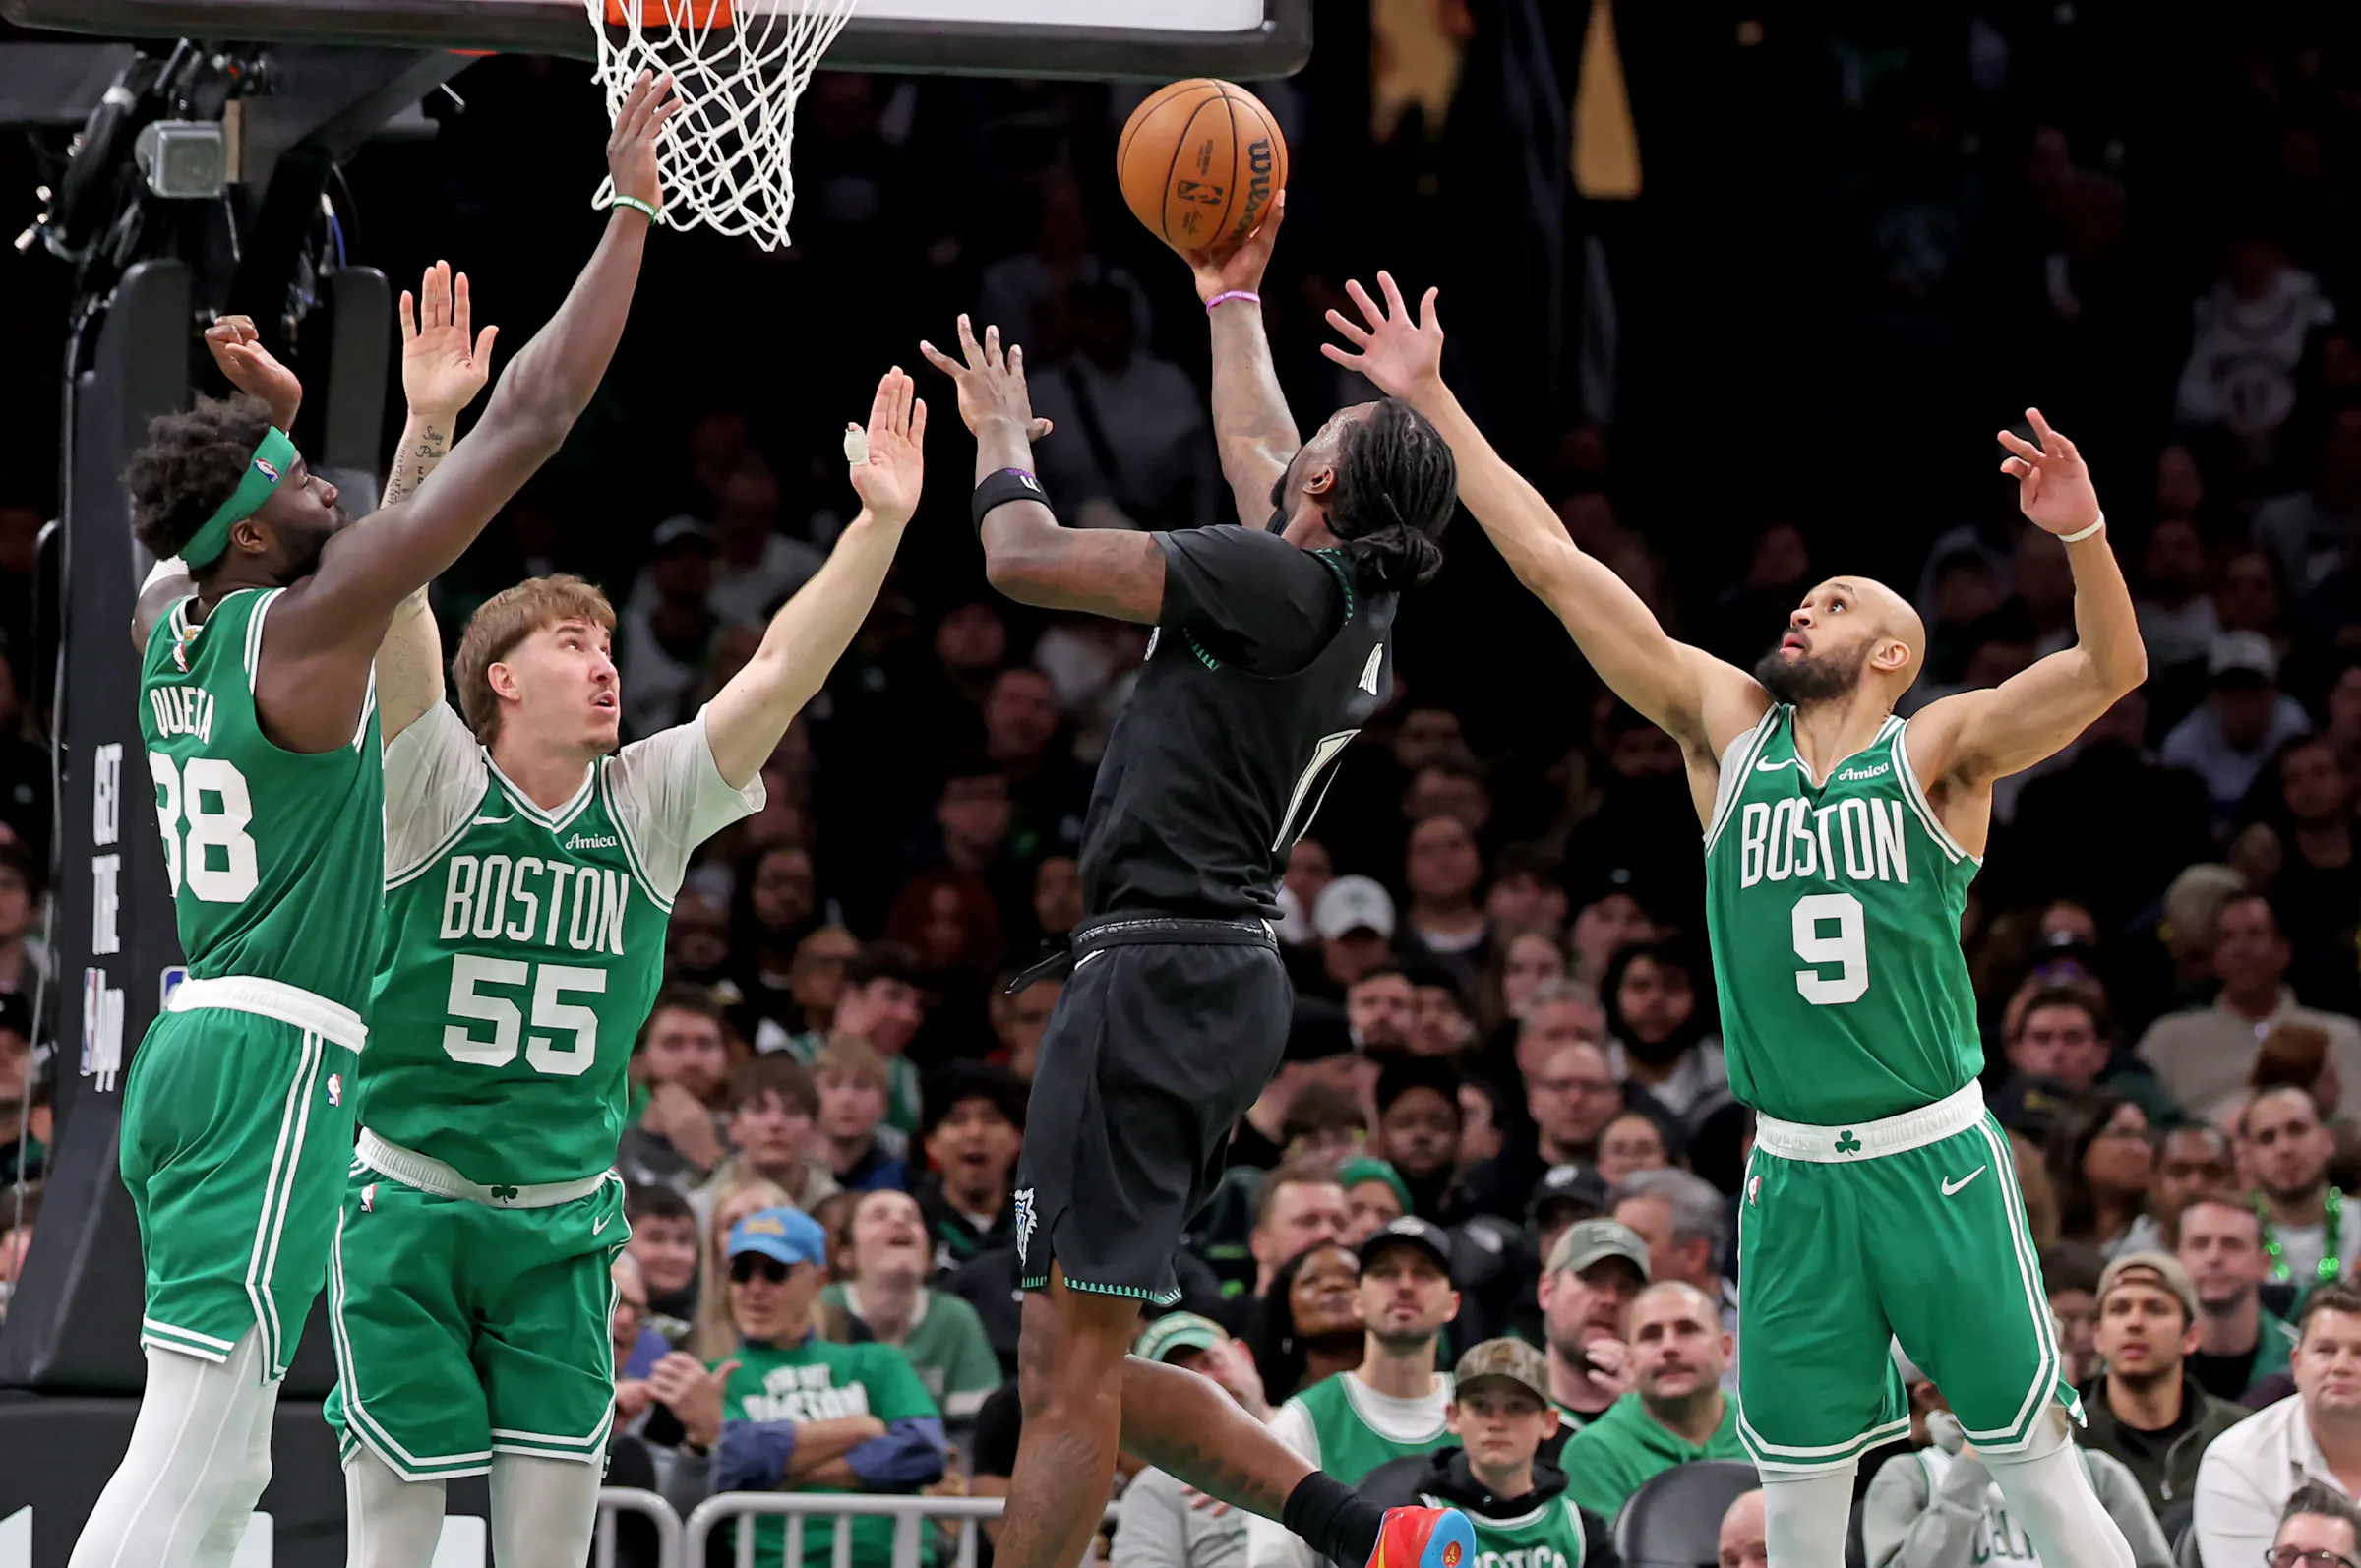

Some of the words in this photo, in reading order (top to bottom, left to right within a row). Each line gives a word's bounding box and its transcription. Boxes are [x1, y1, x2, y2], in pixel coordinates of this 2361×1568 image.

[1838, 761, 1890, 782] Amica
[565, 832, 618, 851] Amica
[1740, 796, 1909, 890] BOSTON
[439, 854, 630, 956] BOSTON
[1790, 892, 1870, 1006] 9
[442, 952, 608, 1077] 55
